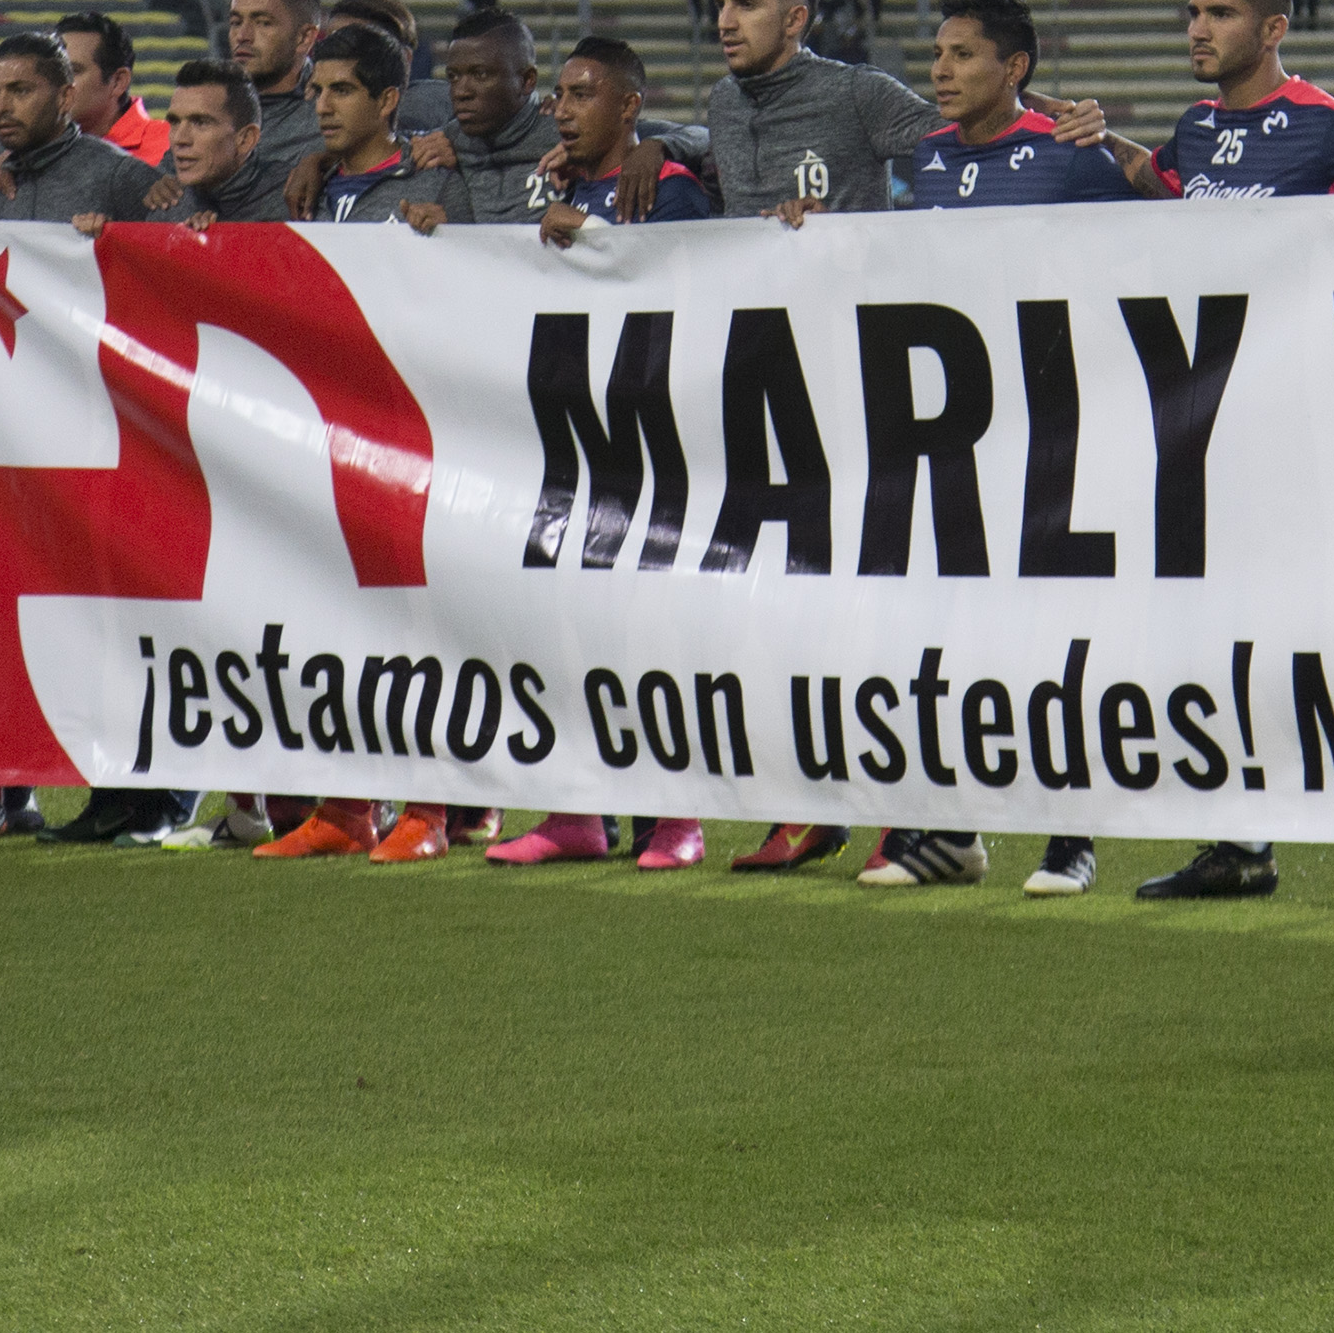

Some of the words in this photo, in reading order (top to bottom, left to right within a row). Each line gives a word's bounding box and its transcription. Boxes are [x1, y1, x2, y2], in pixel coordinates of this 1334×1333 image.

[1211, 129, 1248, 165] 25
[794, 163, 829, 199] 19
[958, 162, 979, 197] 9
[335, 194, 357, 223] 11
[522, 294, 1249, 579] MARLY
[132, 624, 556, 773] ¡estamos
[583, 666, 754, 777] con
[789, 639, 1266, 792] ustedes!
